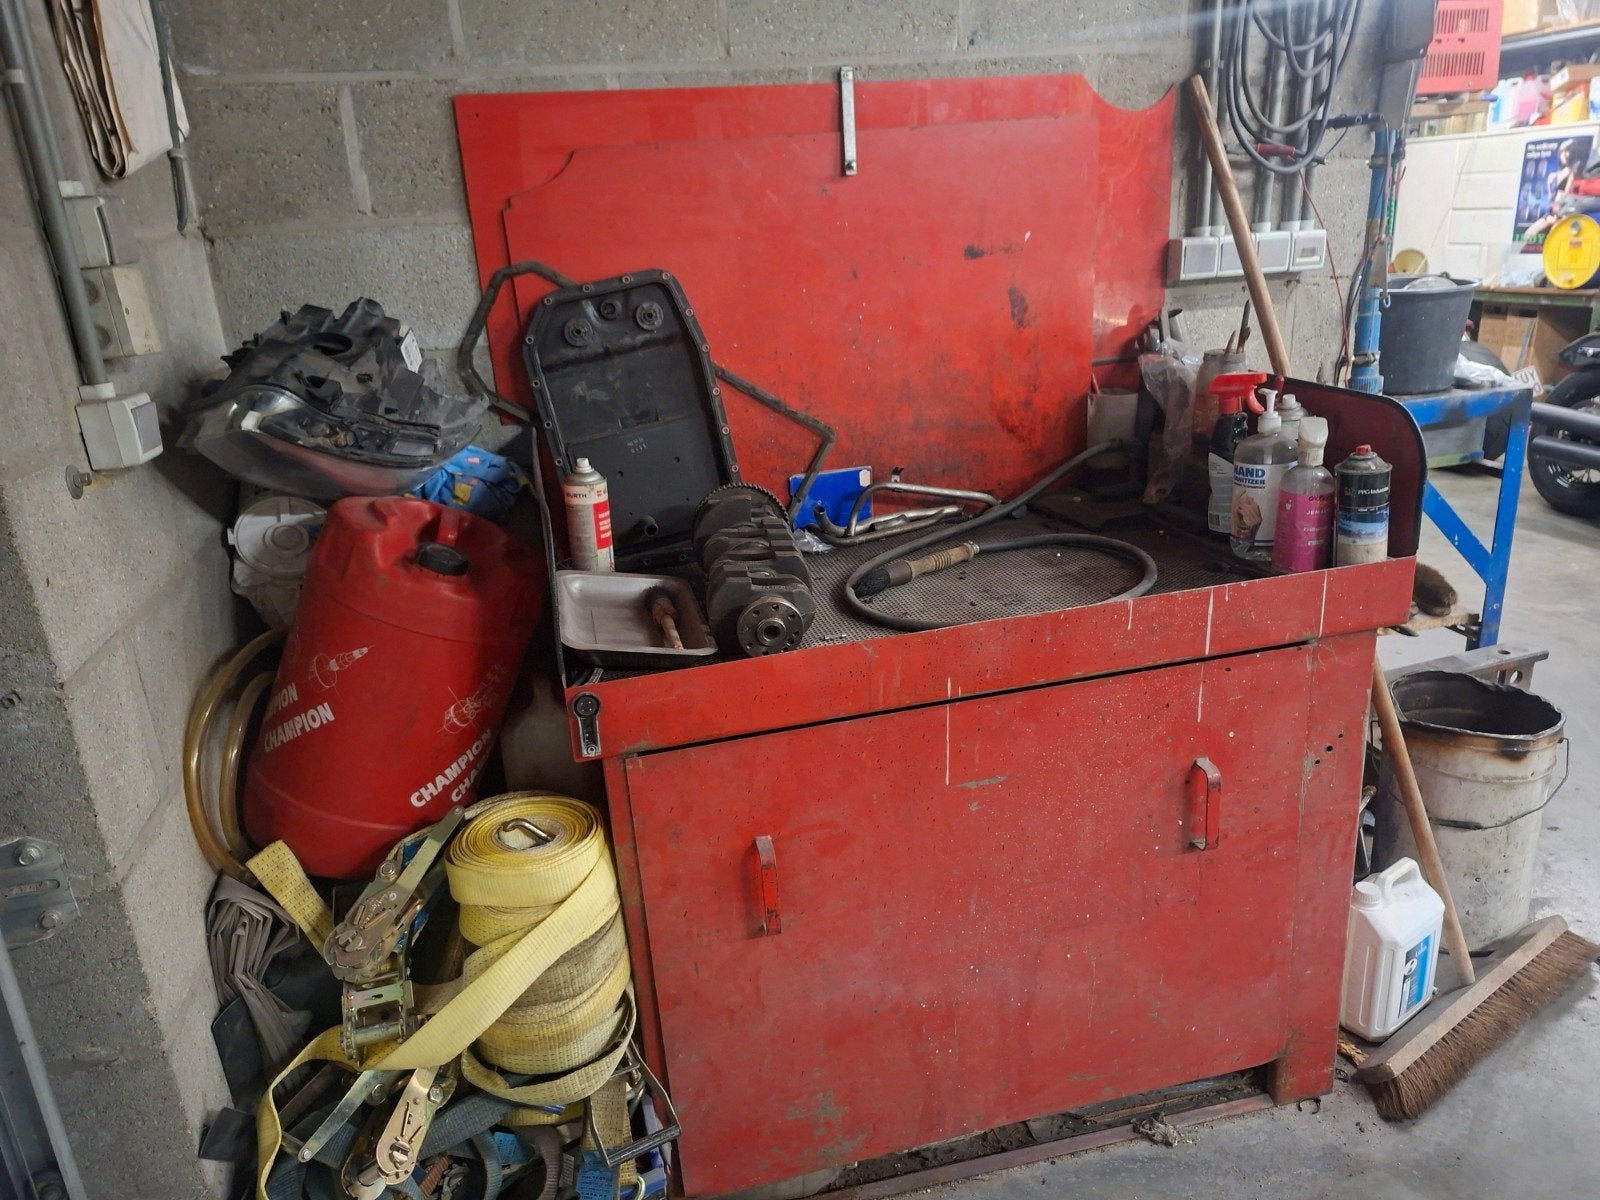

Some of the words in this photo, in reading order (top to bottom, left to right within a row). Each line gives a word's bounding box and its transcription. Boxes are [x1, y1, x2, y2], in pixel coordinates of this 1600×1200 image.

[1234, 464, 1266, 478] HAND
[1234, 475, 1266, 485] ANITIZER
[264, 702, 336, 752] CHAMPION
[410, 729, 491, 808] CHAMPION
